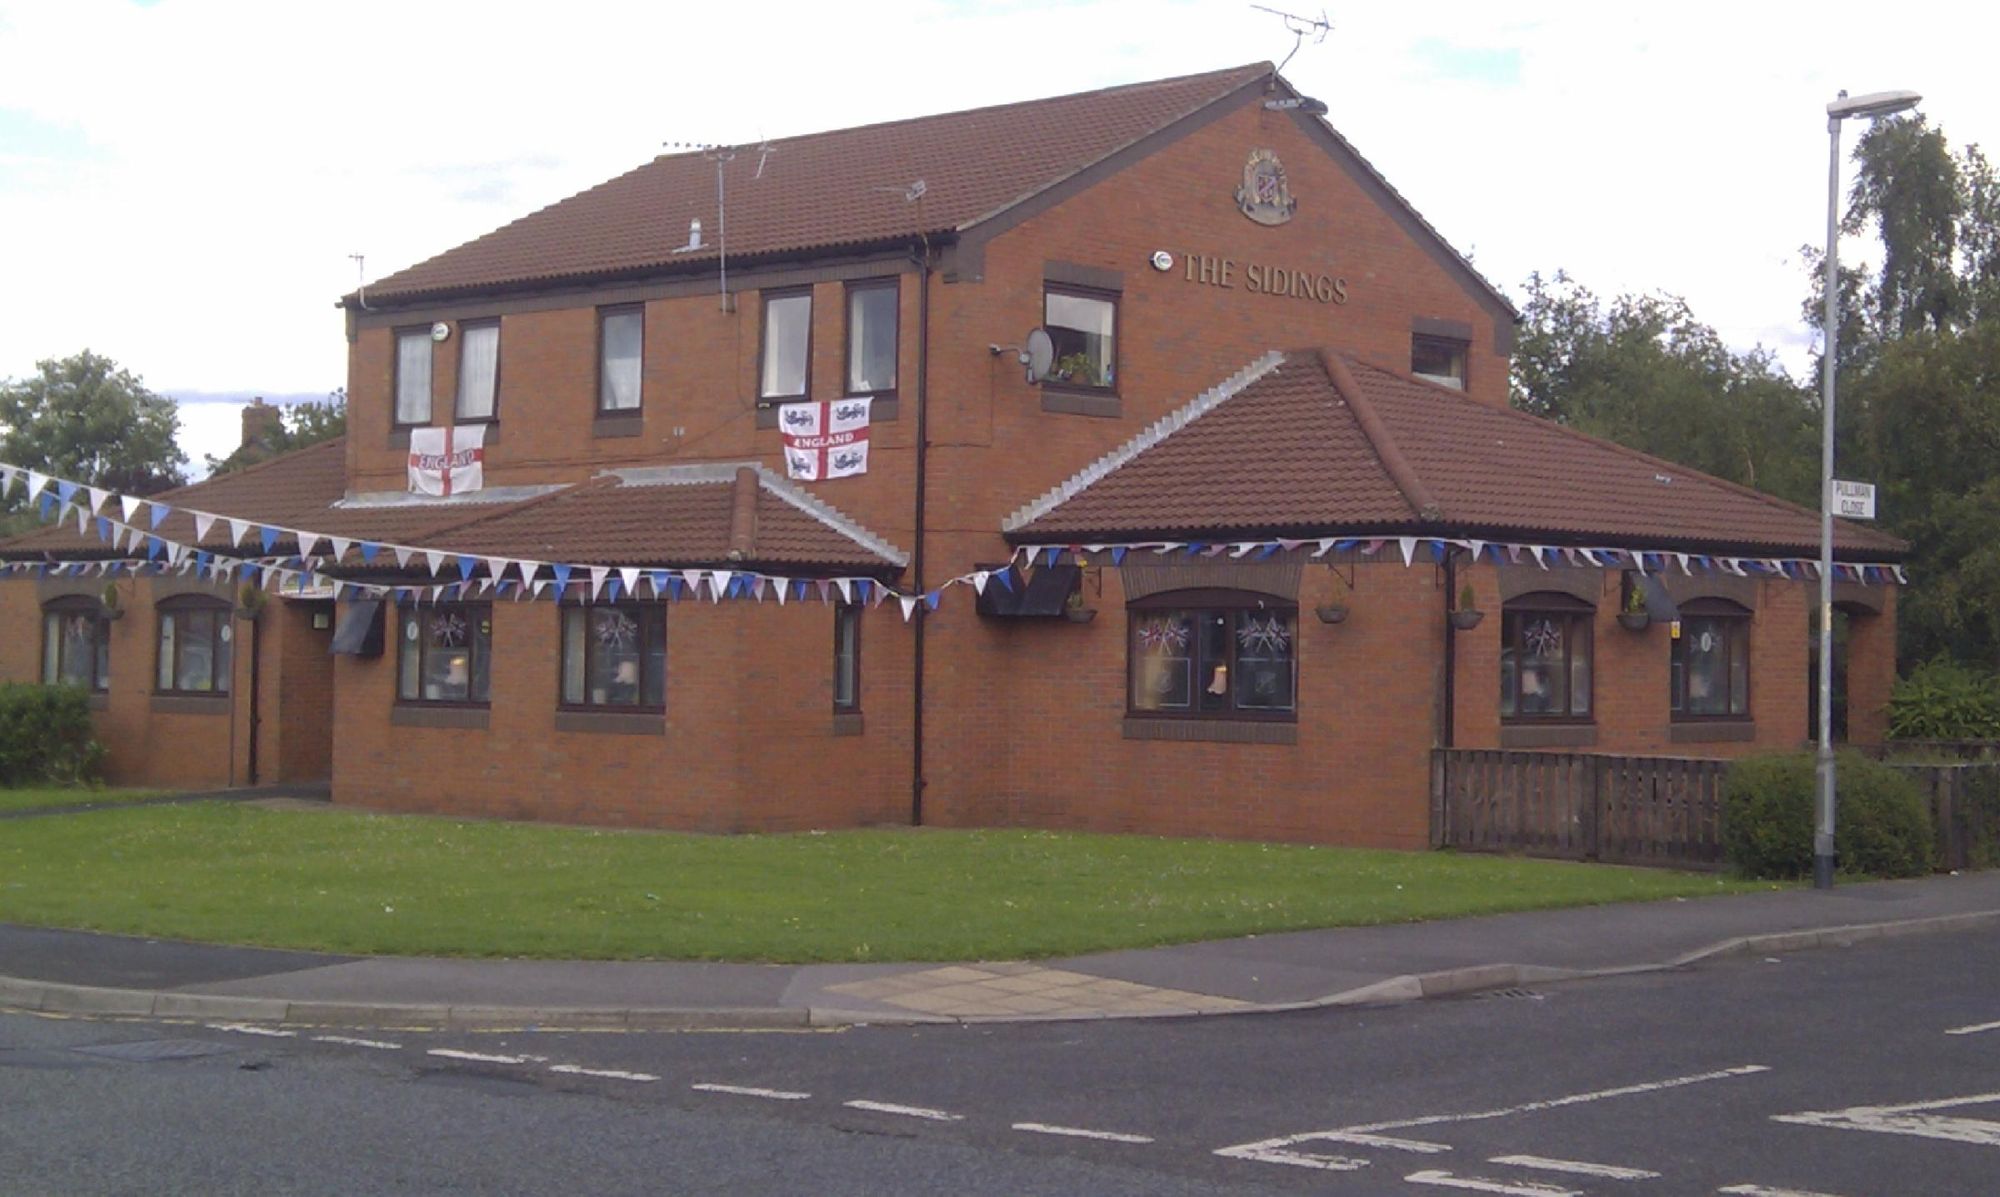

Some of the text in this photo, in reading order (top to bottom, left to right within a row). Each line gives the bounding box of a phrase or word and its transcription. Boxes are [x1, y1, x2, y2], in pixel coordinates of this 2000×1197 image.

[1184, 254, 1349, 305] THE SIDINGS
[793, 433, 854, 448] ENGLAND
[419, 449, 474, 470] ENGLAND
[1841, 500, 1865, 515] CLOSE
